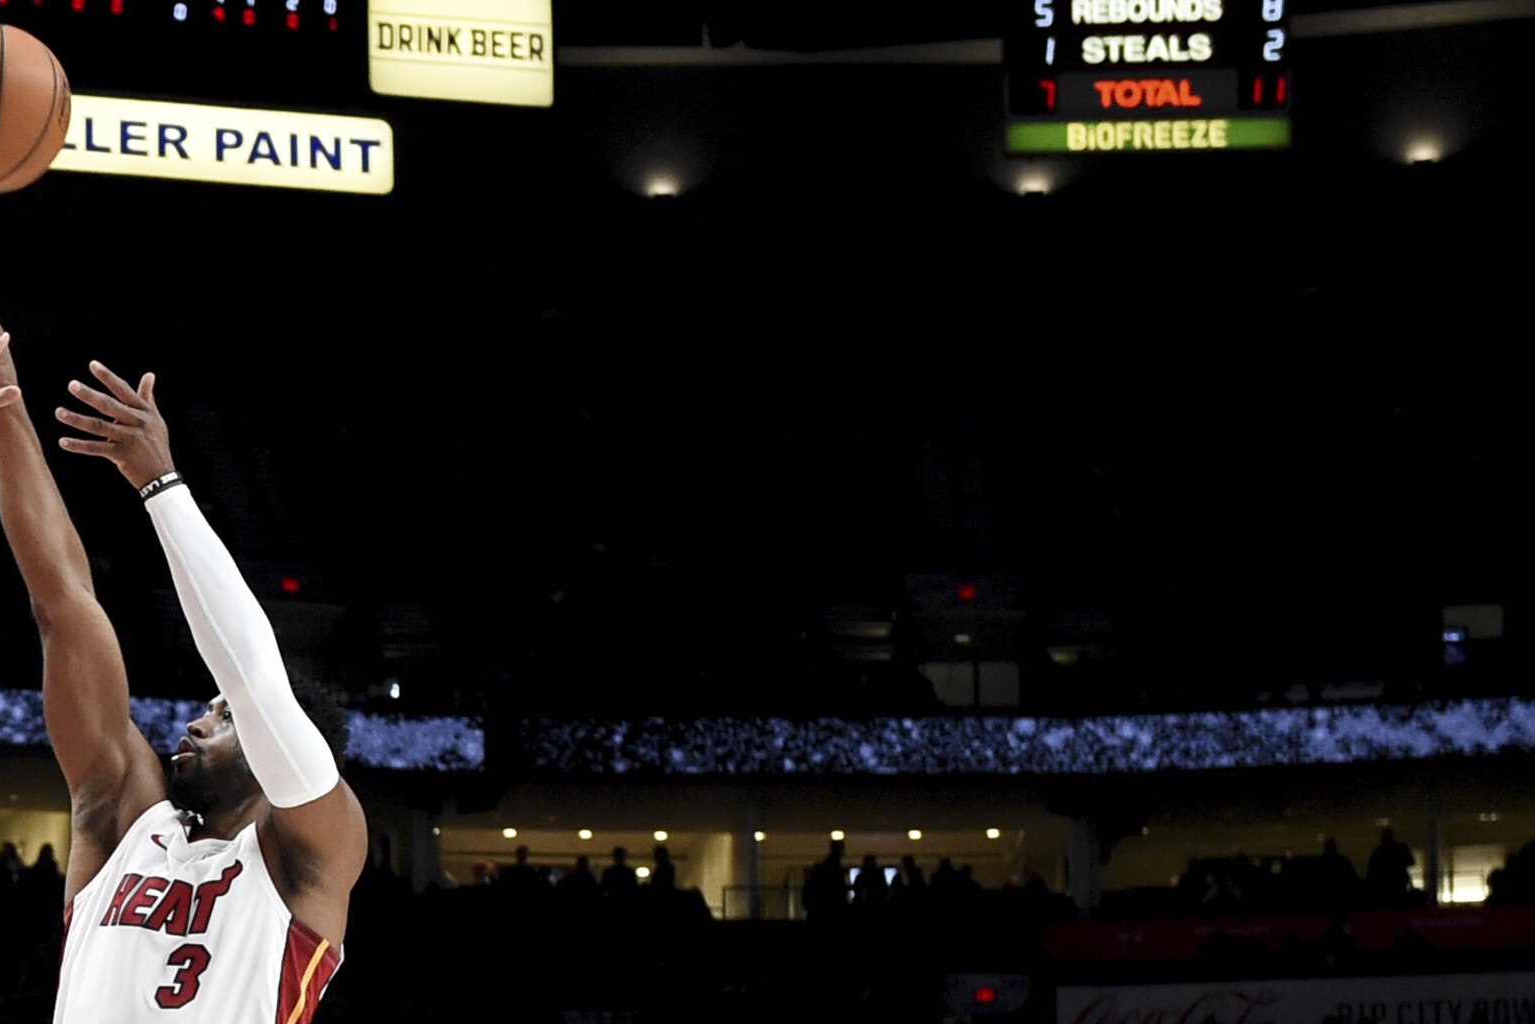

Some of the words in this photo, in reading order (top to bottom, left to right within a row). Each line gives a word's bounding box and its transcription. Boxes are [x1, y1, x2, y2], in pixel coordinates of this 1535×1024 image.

[1071, 0, 1223, 24] REBOUNDS
[377, 22, 462, 55] DRINK
[470, 28, 544, 62] BEER
[1081, 34, 1213, 64] STEALS
[1263, 29, 1285, 61] 2
[1094, 79, 1202, 108] TOTAL
[64, 117, 189, 160] LER
[216, 128, 381, 174] PAINT
[100, 859, 243, 937] HEAT
[154, 943, 212, 1009] 3
